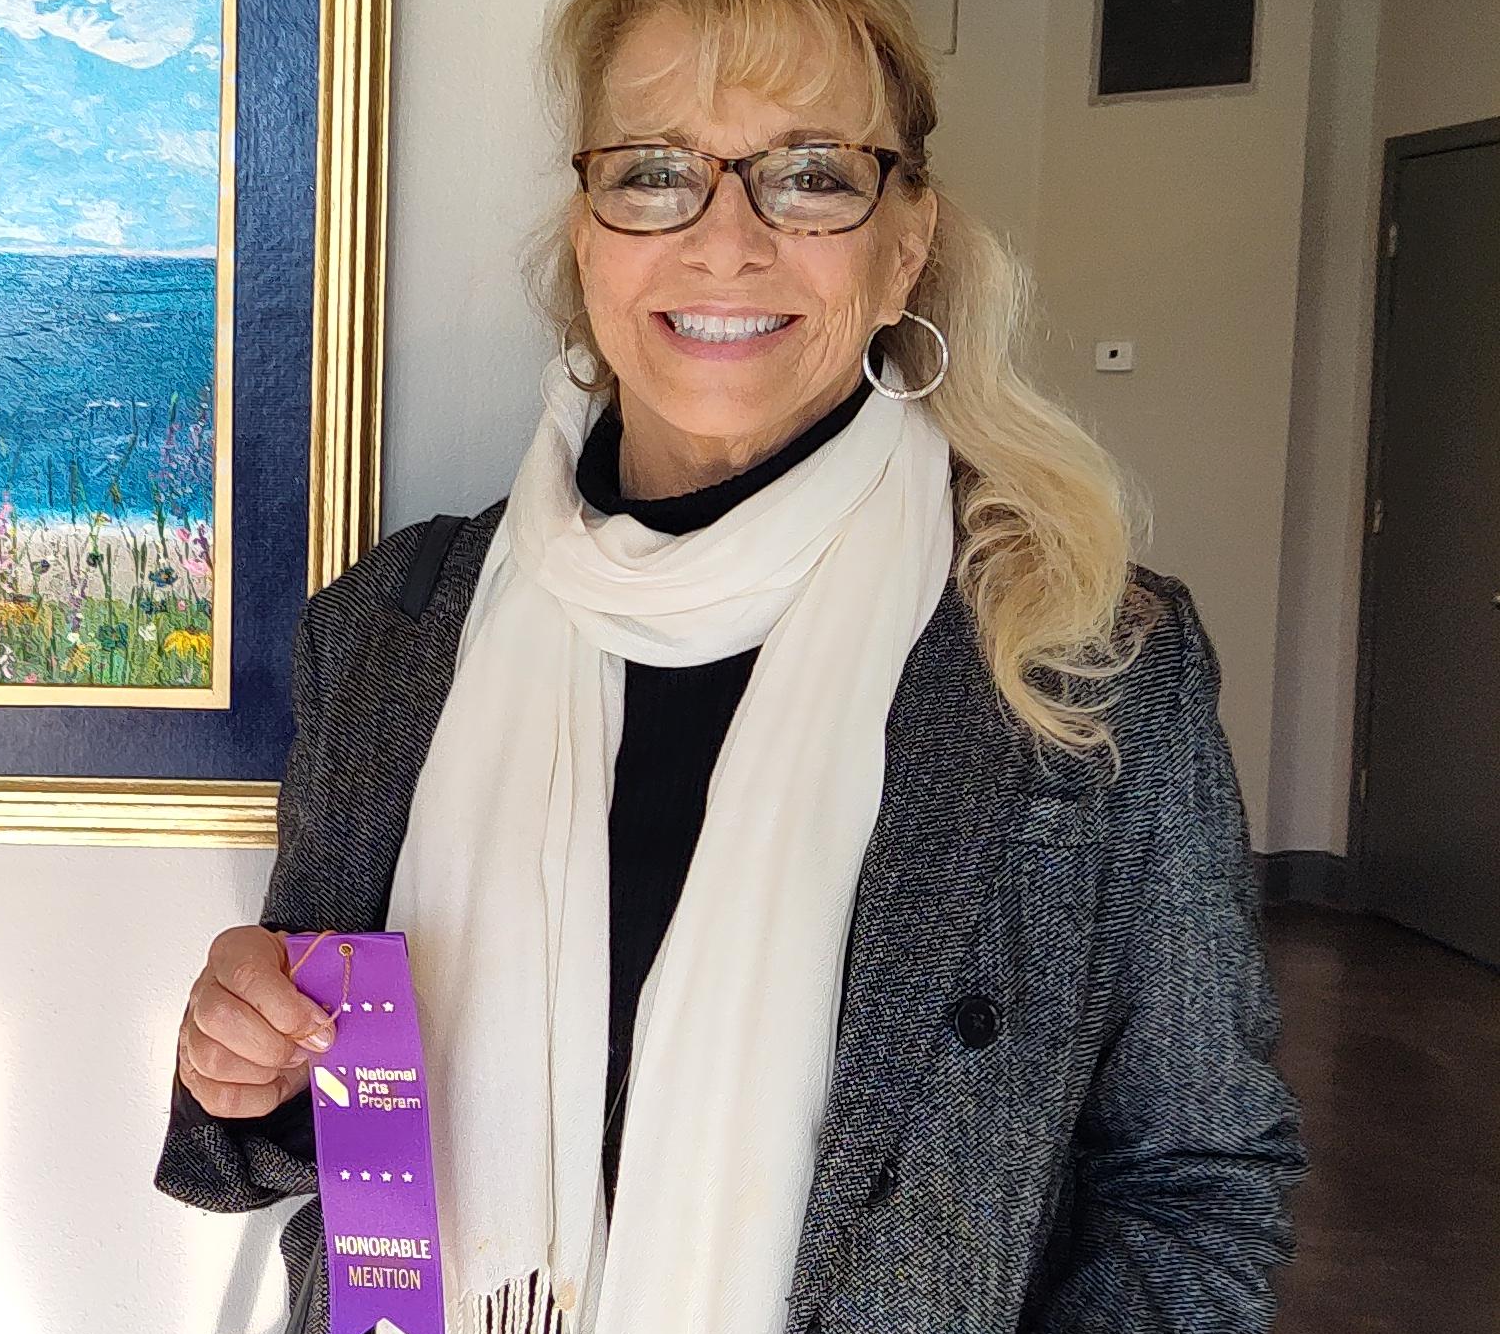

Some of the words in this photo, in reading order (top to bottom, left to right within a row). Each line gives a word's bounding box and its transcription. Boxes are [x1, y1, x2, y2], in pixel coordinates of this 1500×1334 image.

[356, 1066, 417, 1082] National
[358, 1081, 389, 1095] Arts
[358, 1095, 421, 1111] Program
[334, 1235, 431, 1259] HONORABLE
[348, 1266, 421, 1290] MENTION
